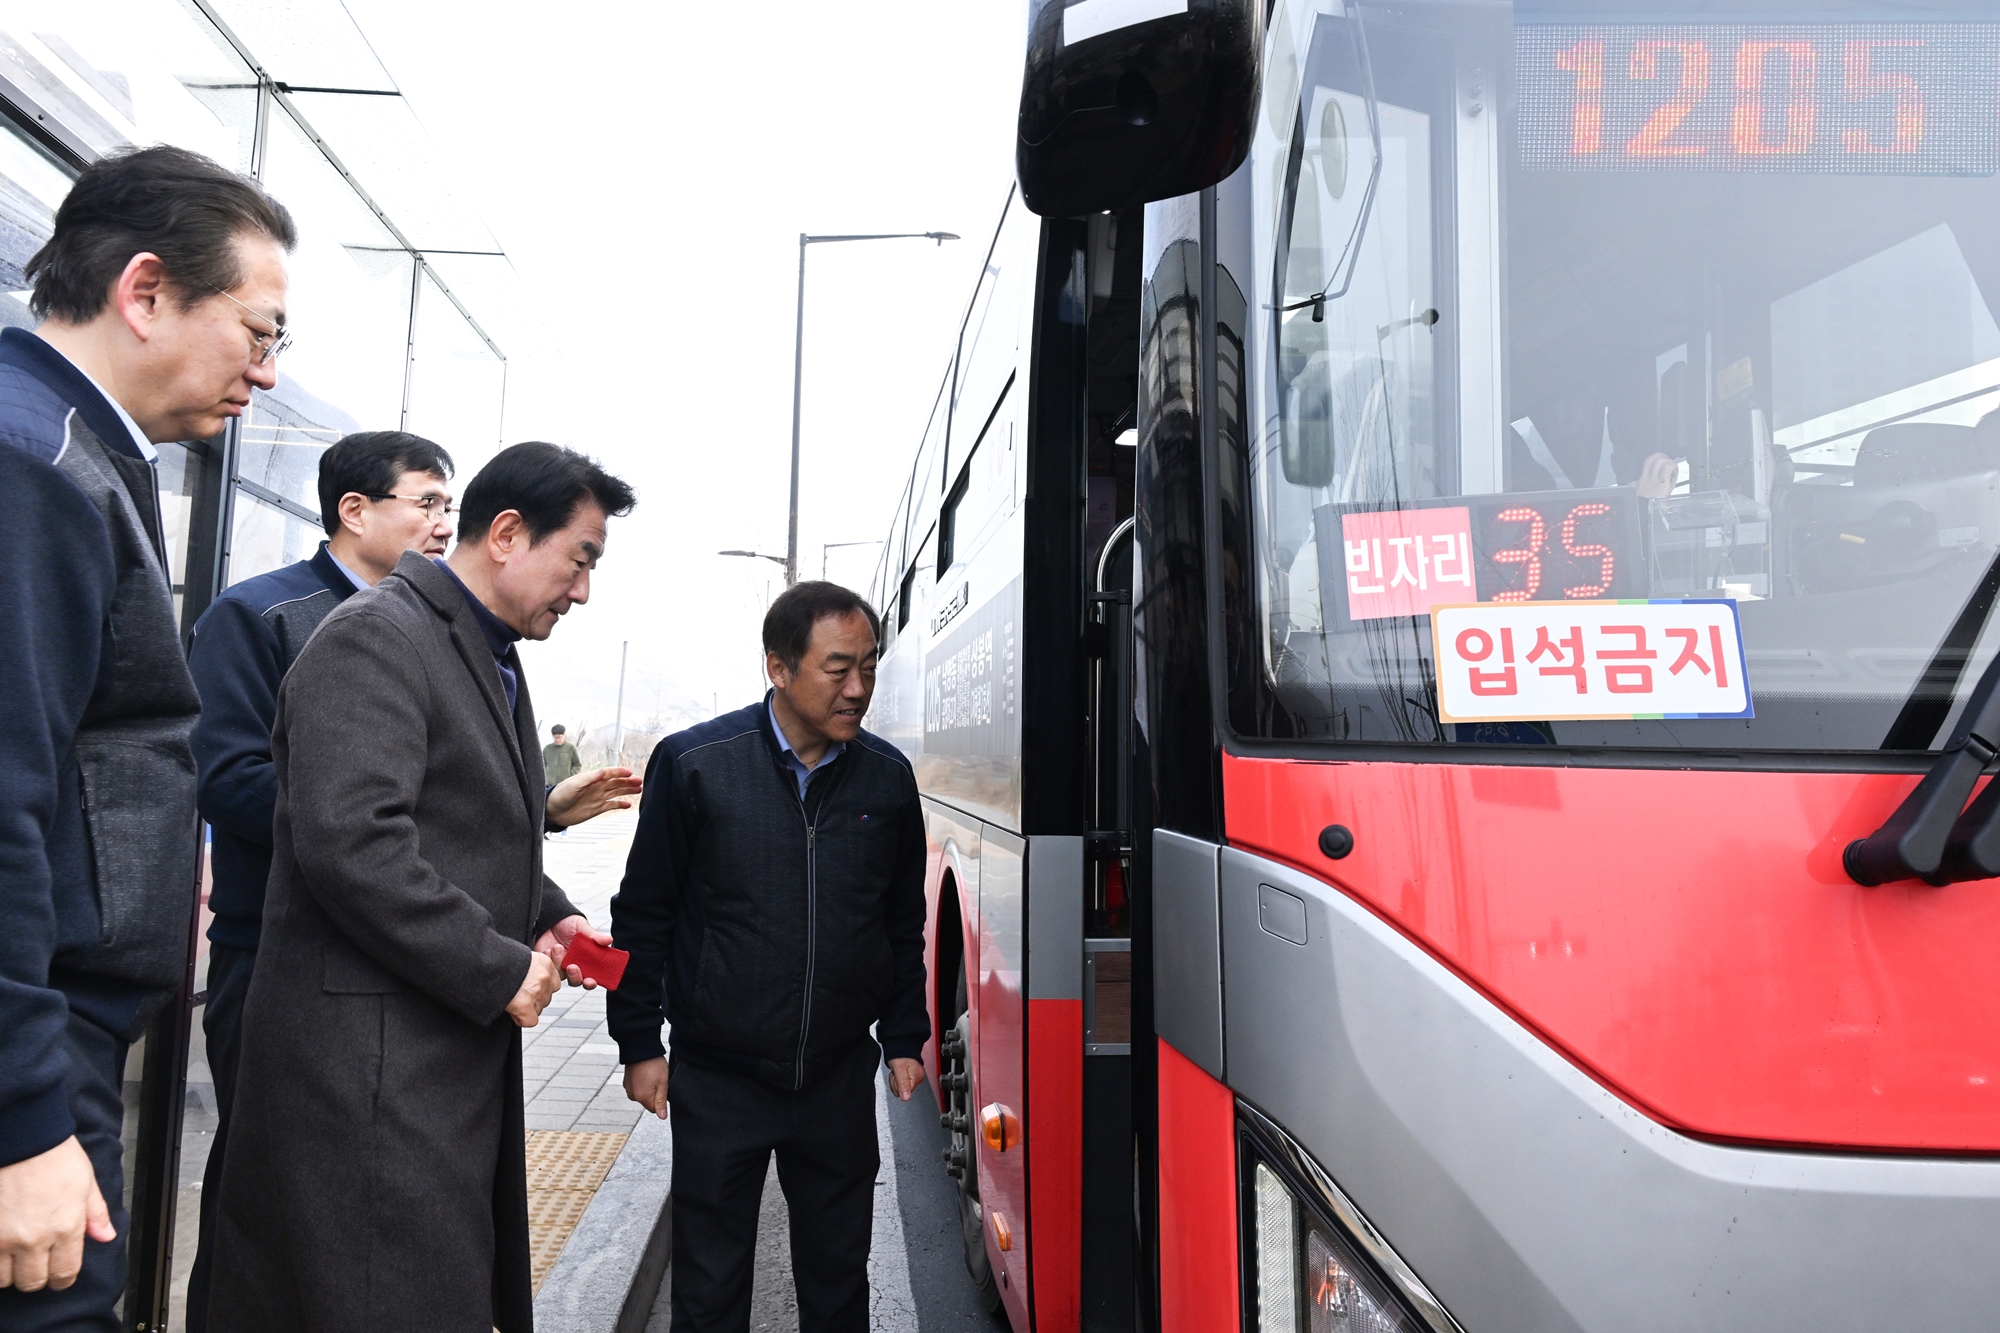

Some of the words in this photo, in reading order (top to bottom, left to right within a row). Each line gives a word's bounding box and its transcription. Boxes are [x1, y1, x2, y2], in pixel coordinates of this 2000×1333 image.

[1556, 37, 1924, 156] 1205
[1344, 531, 1472, 595] 빈자리
[1492, 503, 1614, 602] 35
[942, 654, 957, 692] 낙양동
[970, 627, 993, 679] 상봉역
[1455, 624, 1729, 697] 입석금지
[926, 664, 941, 733] 1205
